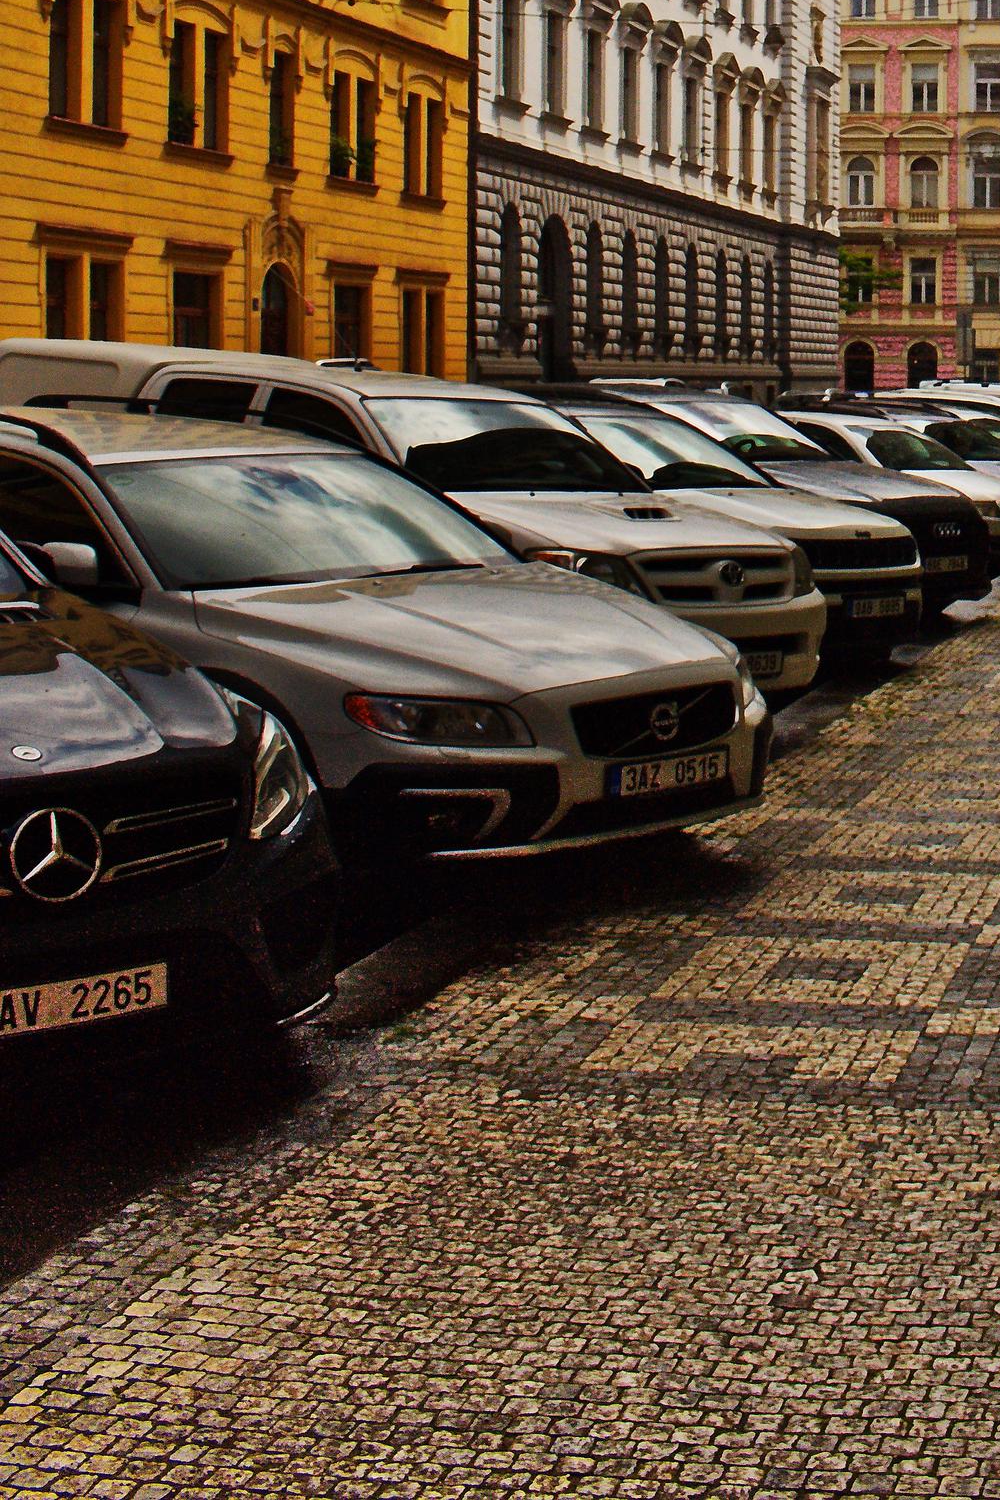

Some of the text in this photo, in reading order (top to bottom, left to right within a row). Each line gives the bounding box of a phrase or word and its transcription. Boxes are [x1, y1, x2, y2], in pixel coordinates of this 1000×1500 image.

[625, 754, 720, 791] 3AZ 0515
[70, 969, 152, 1019] 2265
